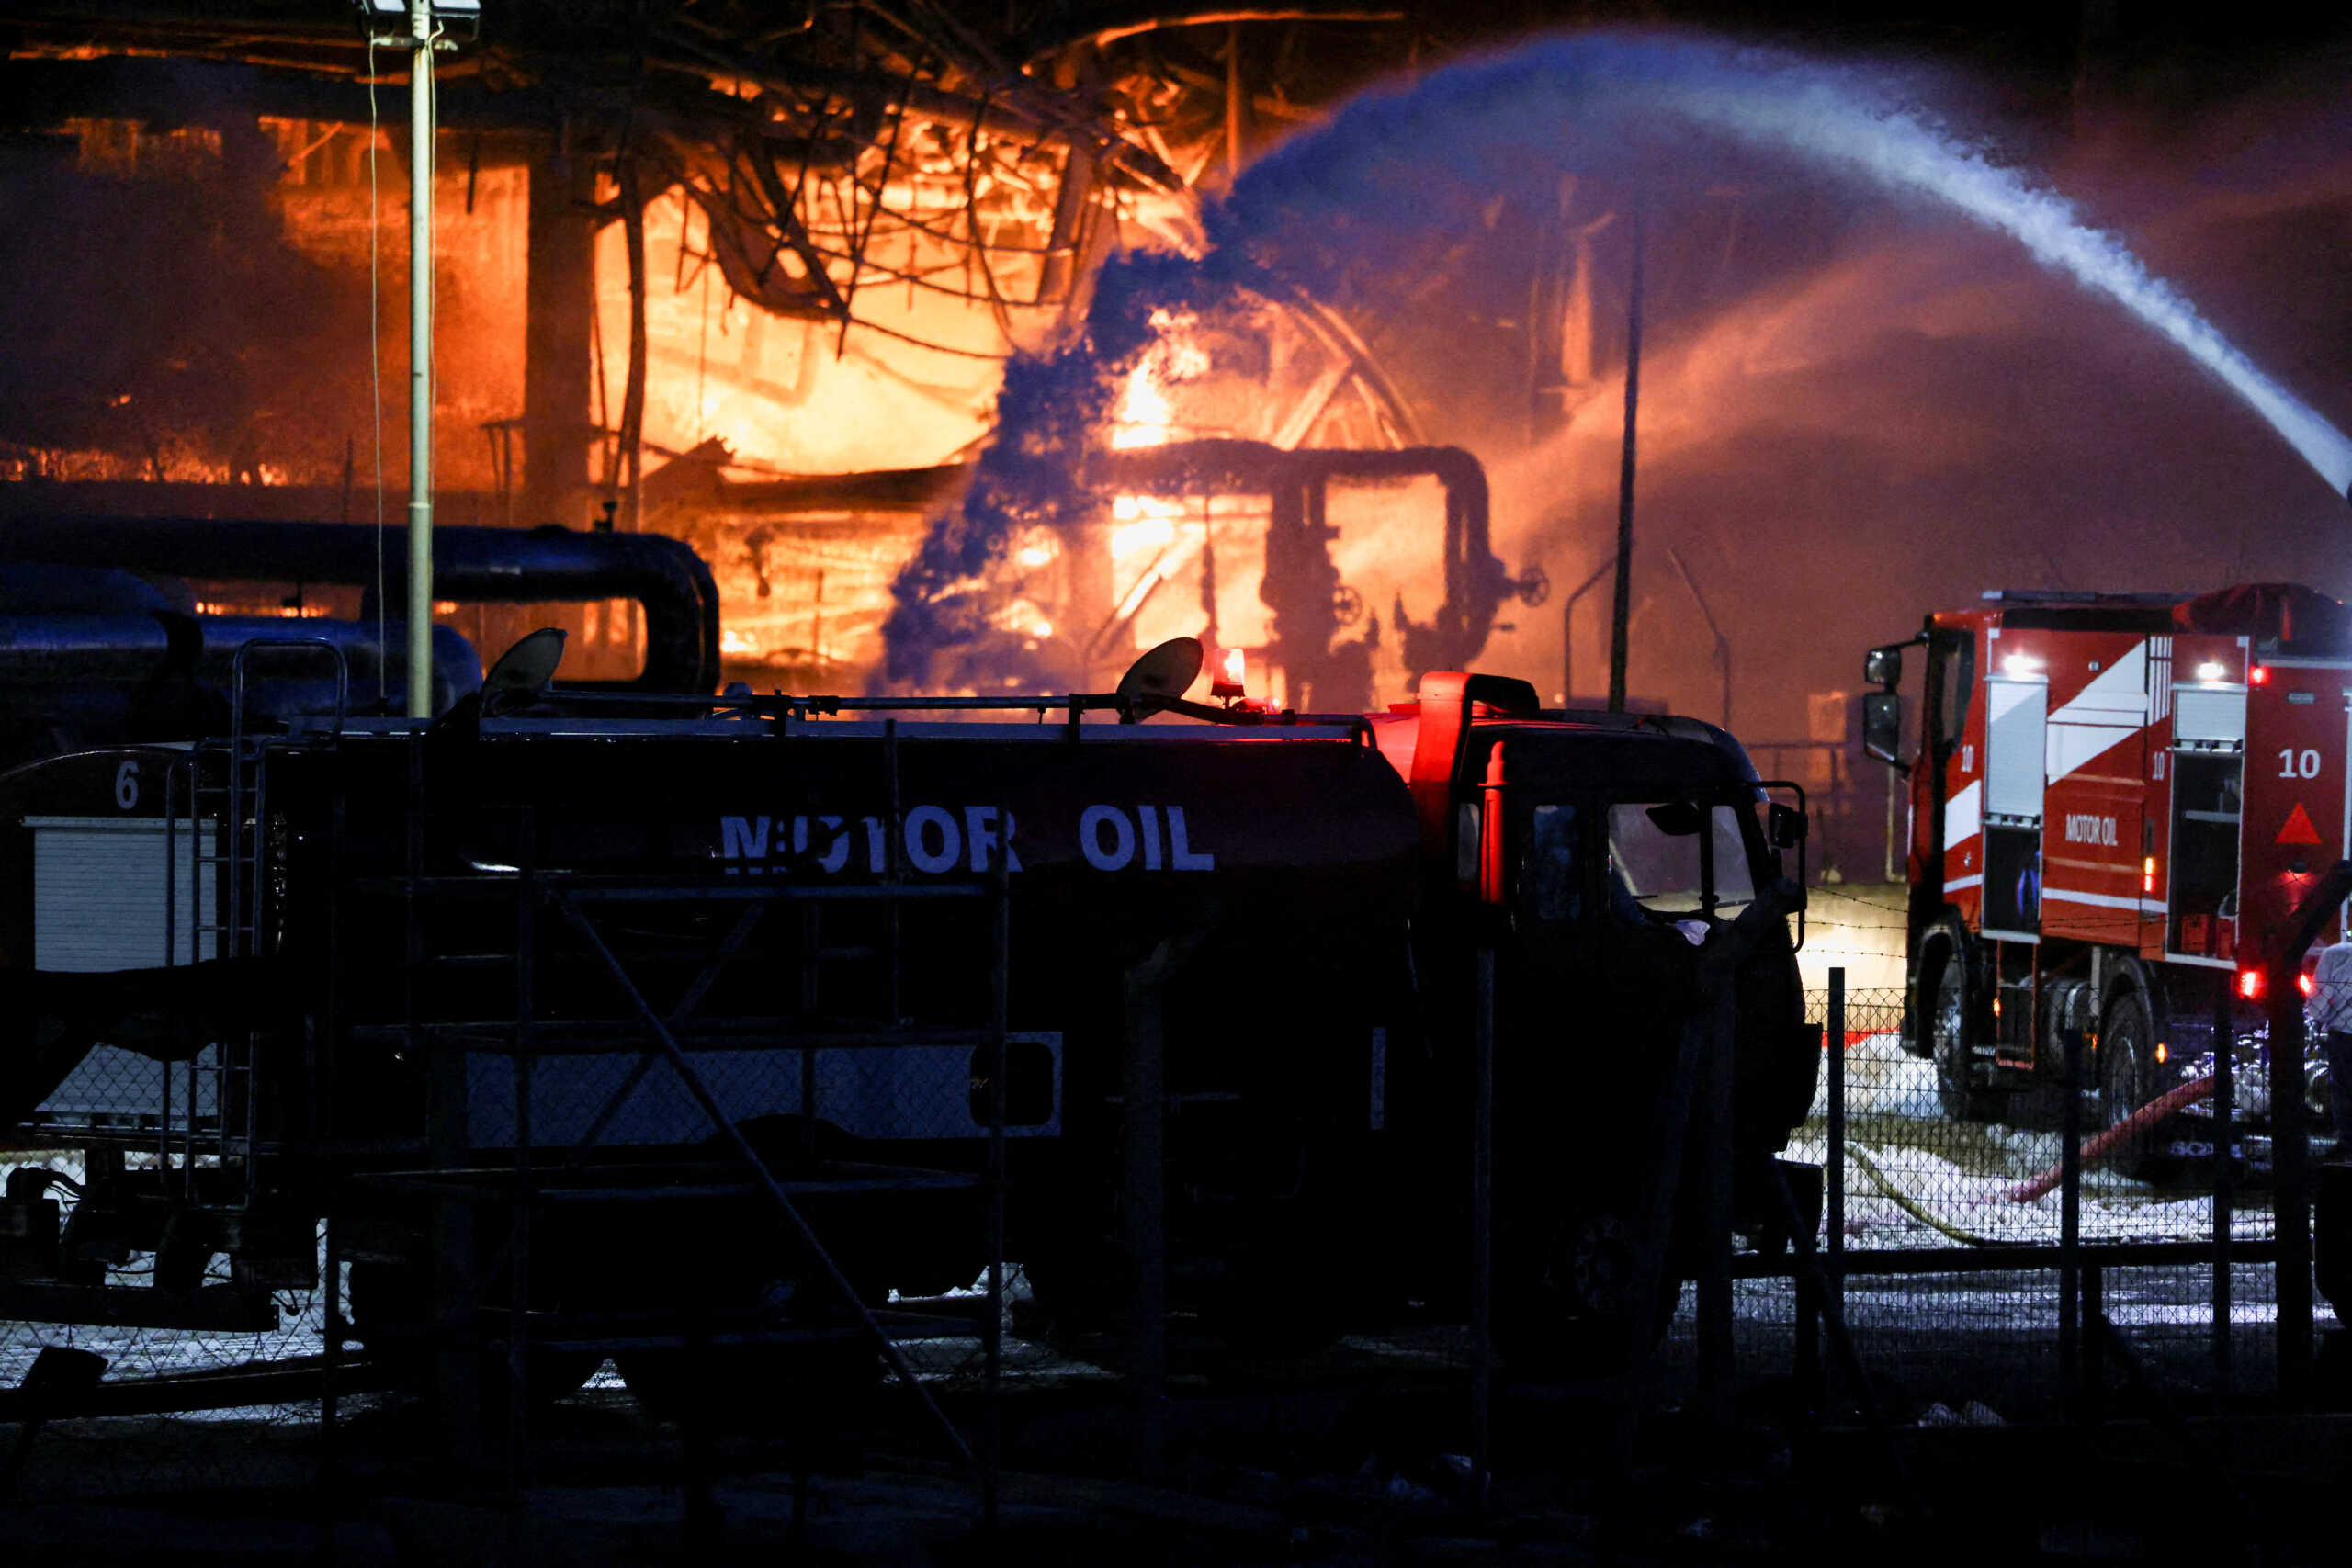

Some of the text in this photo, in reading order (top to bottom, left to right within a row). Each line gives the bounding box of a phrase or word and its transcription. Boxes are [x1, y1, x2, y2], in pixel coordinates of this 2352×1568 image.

[1961, 745, 1974, 773] 10
[2153, 750, 2166, 781] 10
[2278, 747, 2322, 780] 10
[115, 760, 140, 810] 6
[1080, 803, 1216, 873] OIL
[2065, 813, 2119, 847] MOTOR OIL
